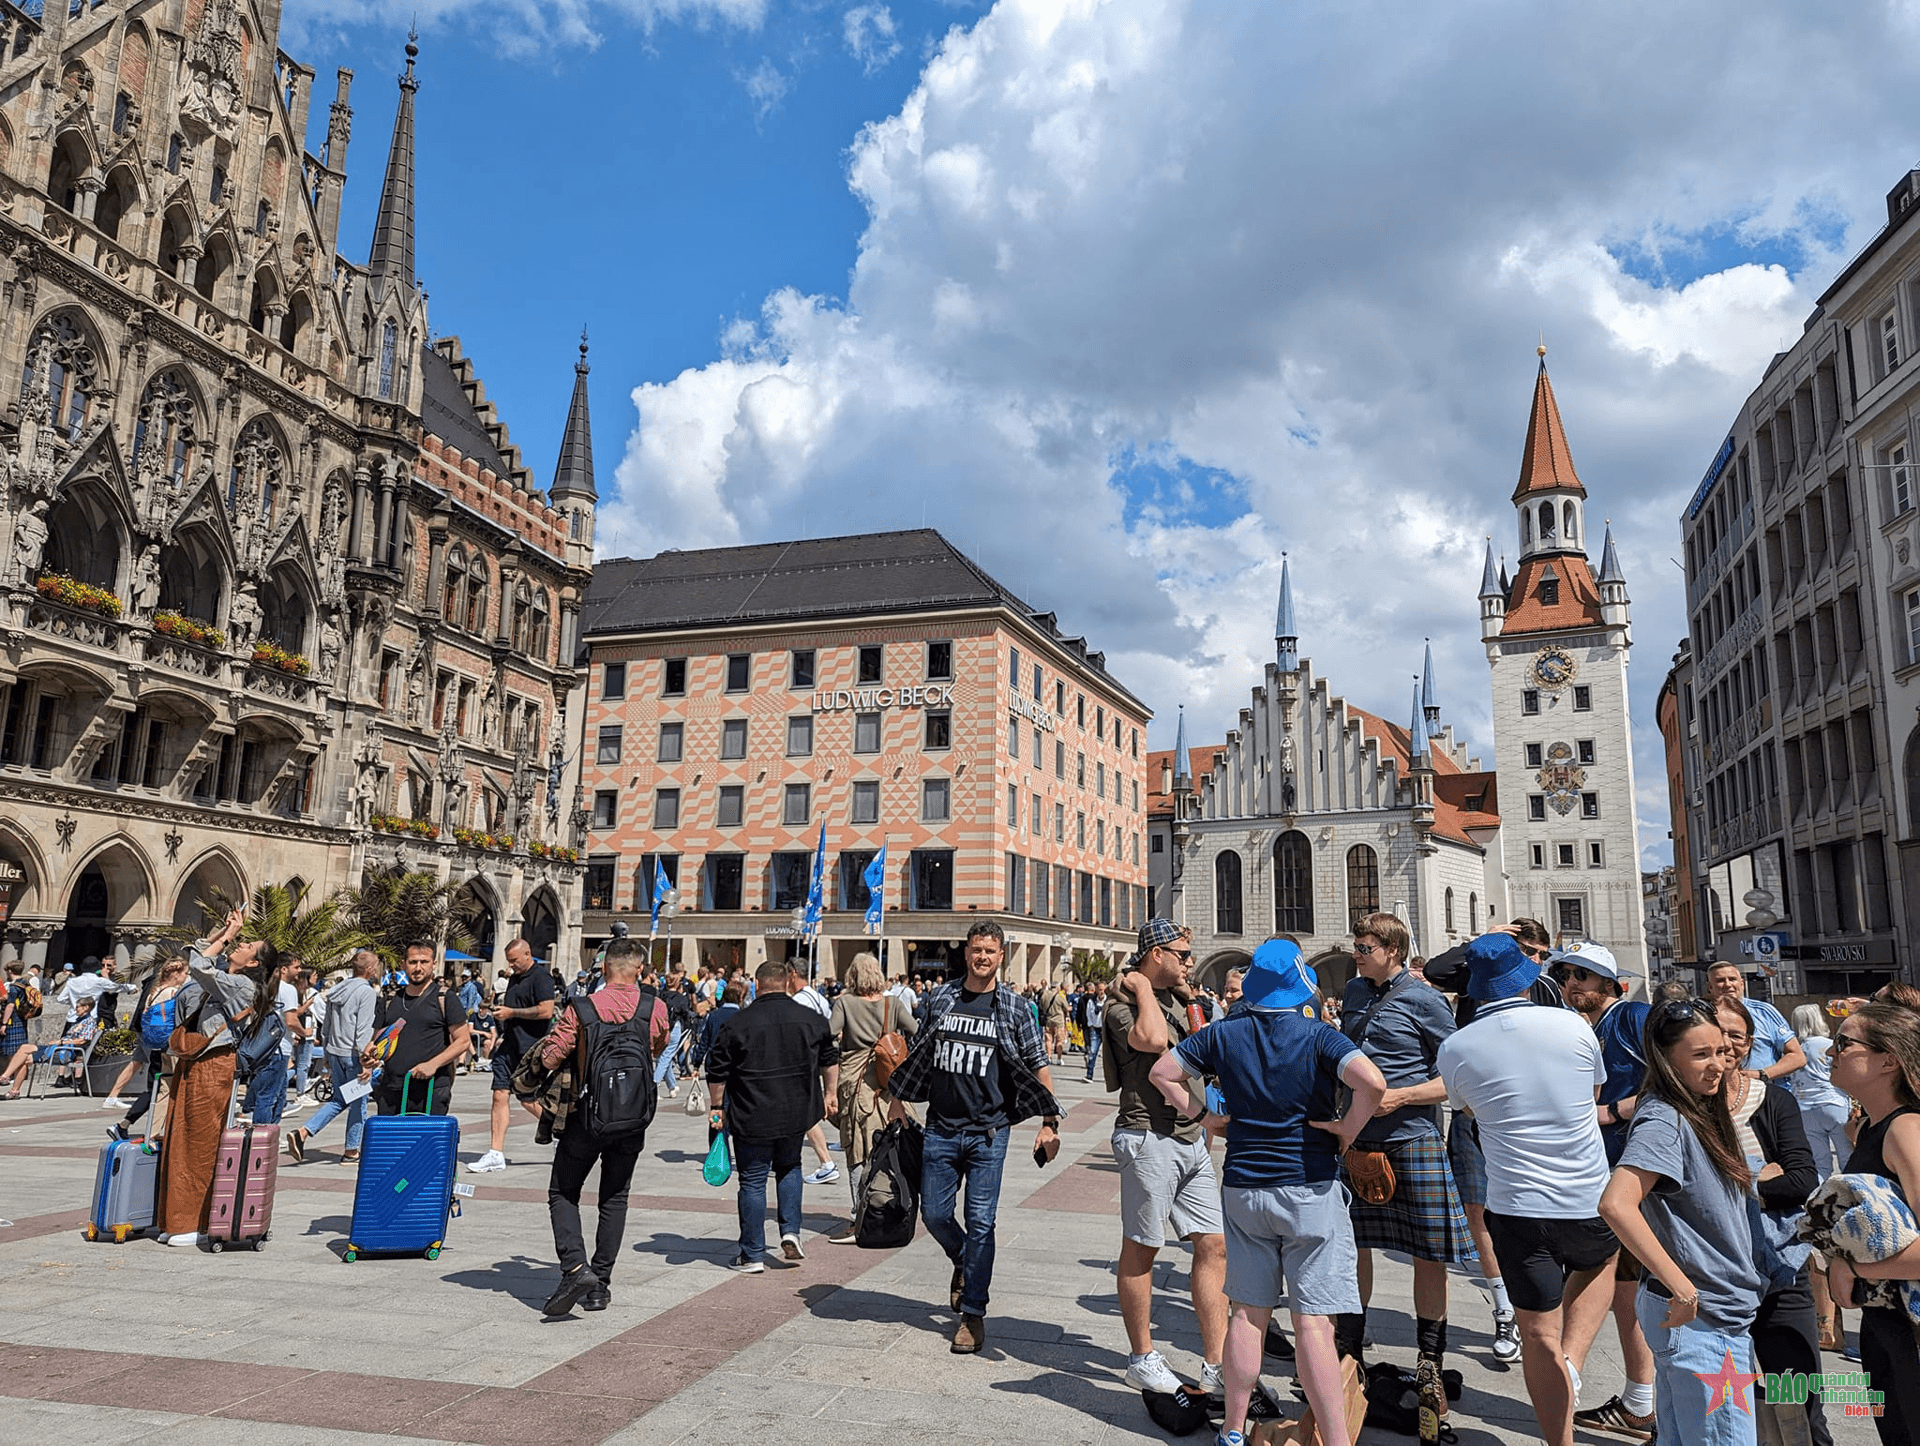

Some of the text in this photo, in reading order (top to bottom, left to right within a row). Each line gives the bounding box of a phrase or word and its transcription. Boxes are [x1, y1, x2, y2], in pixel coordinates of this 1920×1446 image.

[812, 684, 955, 710] LUDWIG BECK
[1009, 690, 1037, 723] LUDWIG
[1820, 944, 1866, 962] SWAROVSKI
[933, 1038, 995, 1077] PARTY
